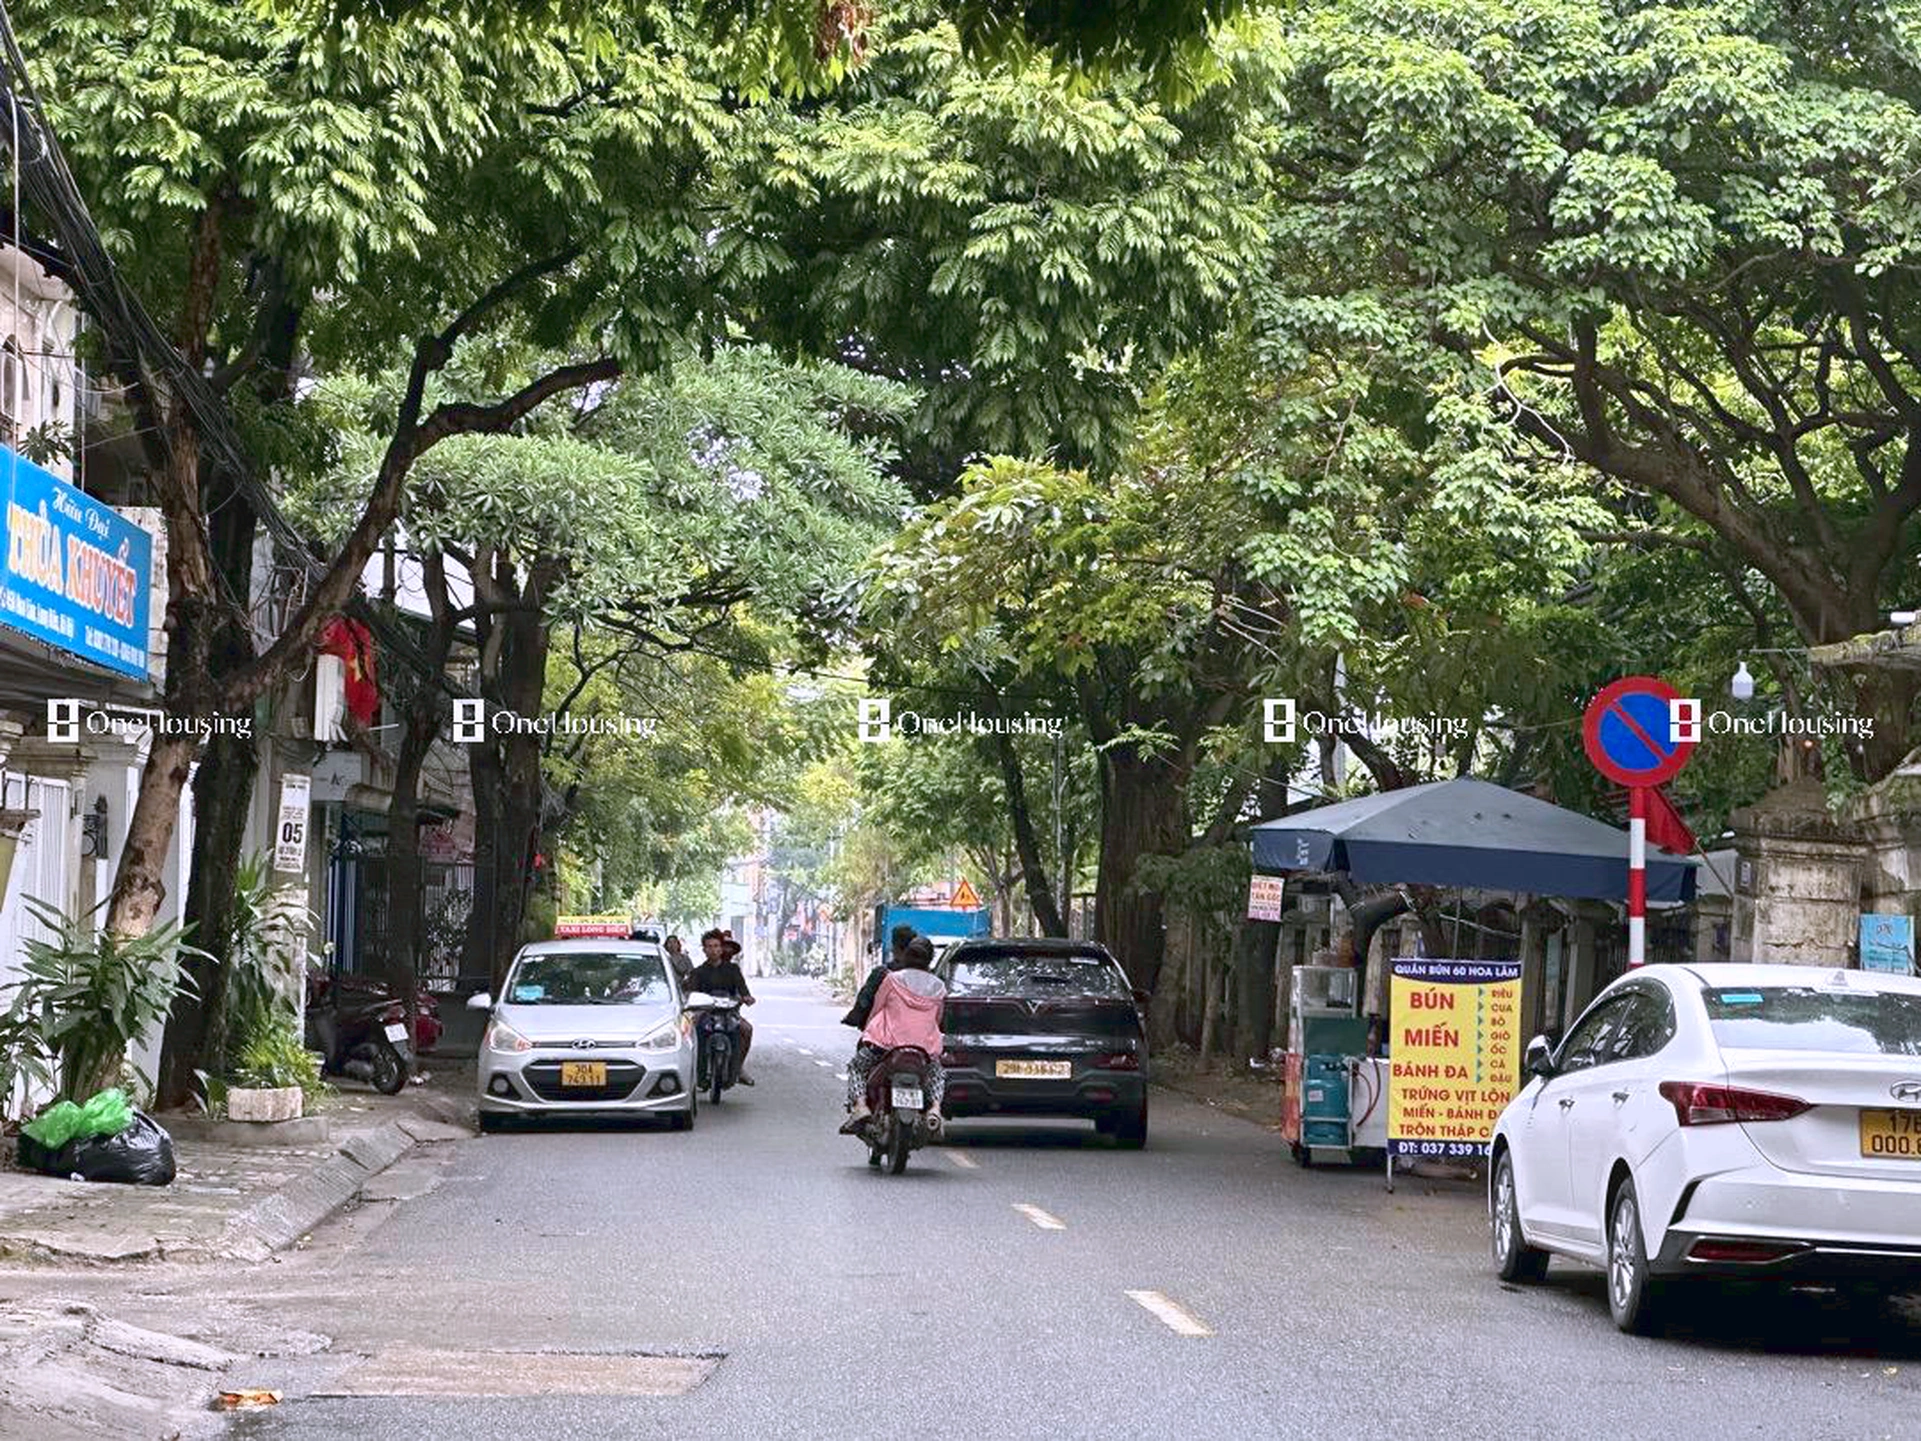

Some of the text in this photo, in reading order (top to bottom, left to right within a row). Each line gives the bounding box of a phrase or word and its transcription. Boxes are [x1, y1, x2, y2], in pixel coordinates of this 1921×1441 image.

[282, 821, 303, 844] 05
[1394, 963, 1426, 974] QUÁN
[1453, 965, 1466, 976] 60
[1469, 965, 1493, 976] HOA
[1410, 987, 1454, 1009] BÚN
[1491, 1003, 1512, 1012] CUA
[1404, 1022, 1459, 1047] MIẾN
[1393, 1061, 1468, 1079] BÁNH ĐA
[1402, 1085, 1510, 1107] TRỨNG VỊT LỘN
[1447, 1105, 1482, 1120] BÁNH
[1398, 1142, 1418, 1154] ĐT:
[1421, 1143, 1445, 1154] 037
[1449, 1144, 1473, 1155] 339
